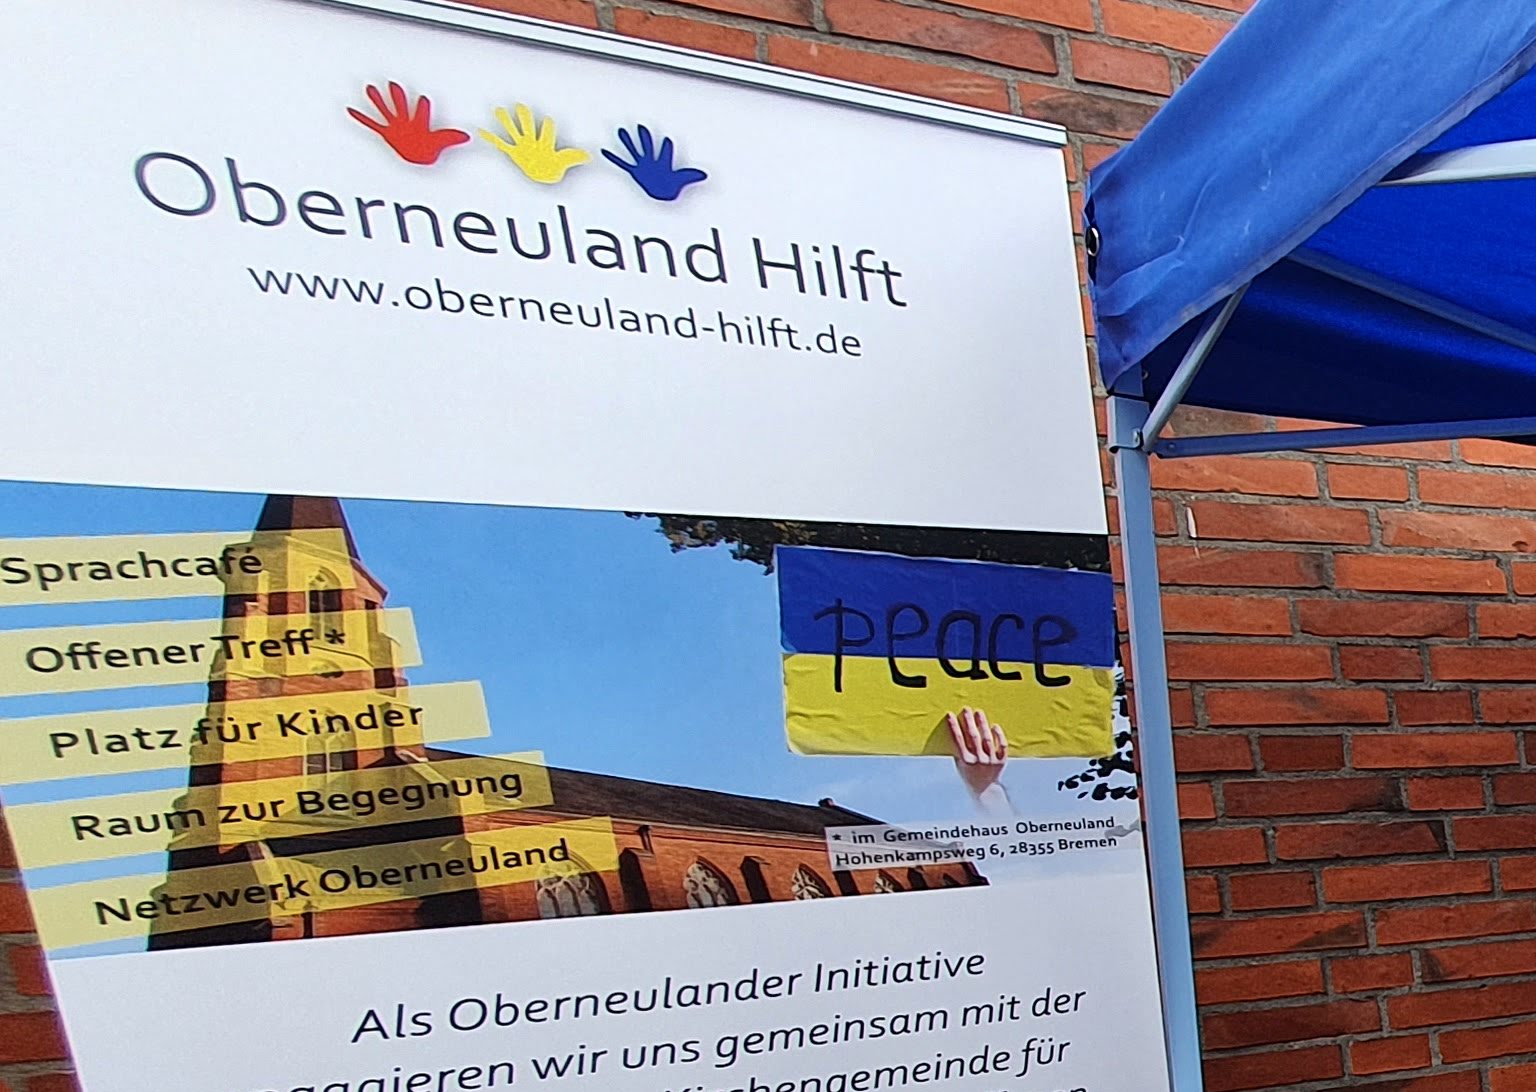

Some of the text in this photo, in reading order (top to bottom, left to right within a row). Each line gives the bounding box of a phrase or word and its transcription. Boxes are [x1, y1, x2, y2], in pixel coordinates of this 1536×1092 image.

[134, 148, 907, 308] Oberneuland Hilft
[246, 267, 862, 357] www.oberneuland-hilft.de
[1, 547, 262, 590] Sprachcafé
[26, 639, 205, 673] Offener
[211, 628, 314, 661] Treff
[814, 598, 1078, 692] peace
[51, 703, 424, 758] Platz für Kinder
[72, 772, 523, 840] Raum zur Begegnung
[852, 829, 875, 845] im
[884, 823, 1009, 843] Gemeindehaus
[1015, 816, 1115, 833] Oberneuland
[95, 838, 570, 925] Netzwerk Oberneuland
[836, 835, 1117, 866] Hohenkampsweg 6, 28355 Bremen
[351, 951, 986, 1044] Als Oberneulander Initiative
[531, 1045, 609, 1080] wir
[623, 1038, 701, 1070] uns
[714, 1003, 949, 1066] gemeinsam
[962, 995, 1021, 1027] mit
[1031, 987, 1087, 1018] der
[1016, 1037, 1071, 1077] für
